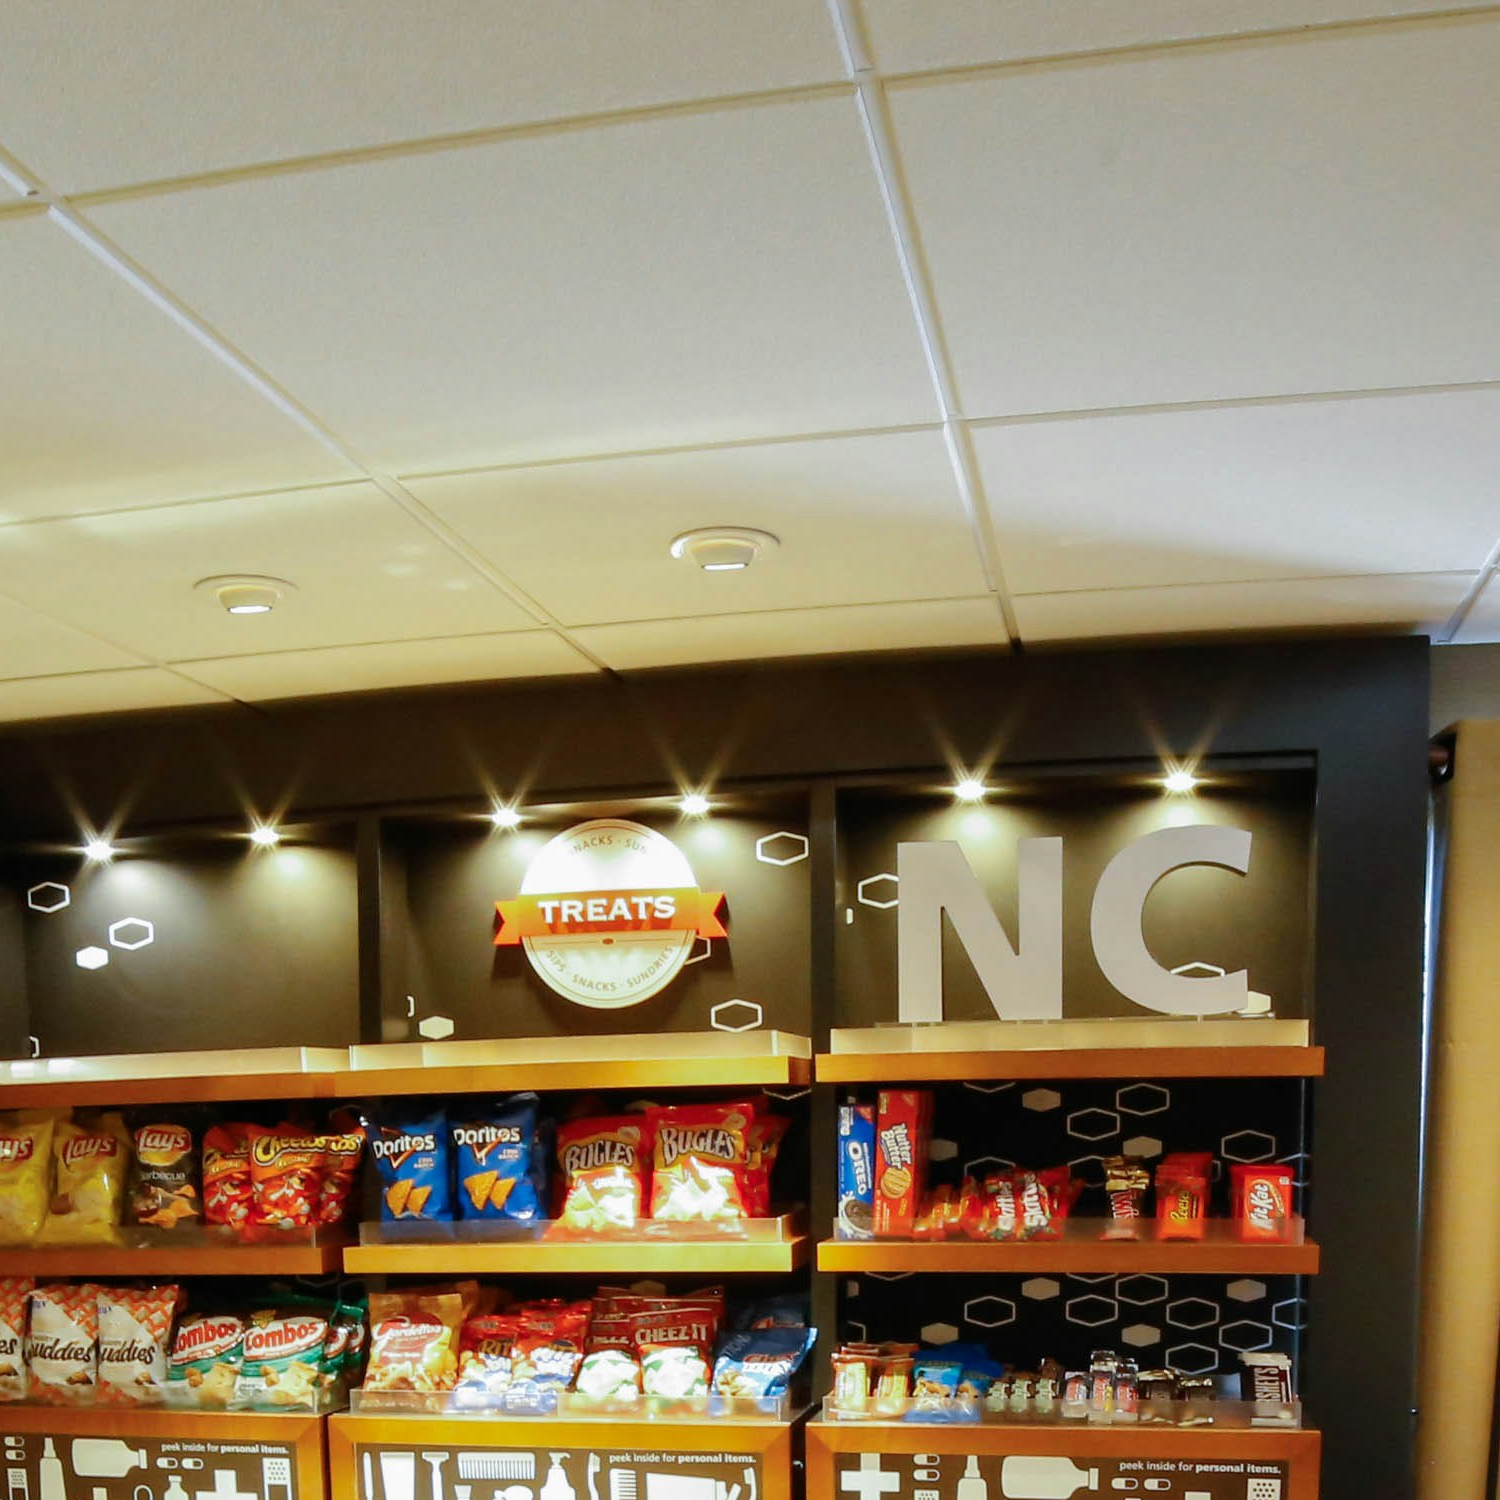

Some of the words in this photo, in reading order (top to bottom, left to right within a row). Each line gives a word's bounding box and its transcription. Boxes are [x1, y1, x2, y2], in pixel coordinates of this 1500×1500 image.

[572, 834, 614, 855] NACKS
[536, 895, 677, 924] TREATS
[898, 825, 1253, 1023] NC
[546, 950, 566, 973] SIPS
[571, 974, 618, 992] SNACKS
[626, 945, 674, 988] SUNDRIES
[373, 1134, 435, 1159] Doritos
[453, 1126, 520, 1146] Doritos
[660, 1127, 736, 1165] BUGLES
[880, 1129, 902, 1169] Butter
[892, 1122, 912, 1165] Nutter
[565, 1140, 635, 1177] BUGLES
[848, 1141, 868, 1195] OREO
[100, 1338, 156, 1364] uddies
[244, 1321, 318, 1352] Combos
[481, 1339, 513, 1356] RIT
[161, 1442, 180, 1453] peek
[207, 1442, 219, 1452] for
[221, 1443, 260, 1455] personal
[609, 1452, 631, 1464] peek
[634, 1453, 660, 1463] inside
[662, 1453, 676, 1463] for
[678, 1453, 722, 1465] personal
[1119, 1461, 1144, 1471] peek
[1146, 1462, 1176, 1471] inside
[1178, 1461, 1193, 1472] for
[1195, 1463, 1244, 1474] personal
